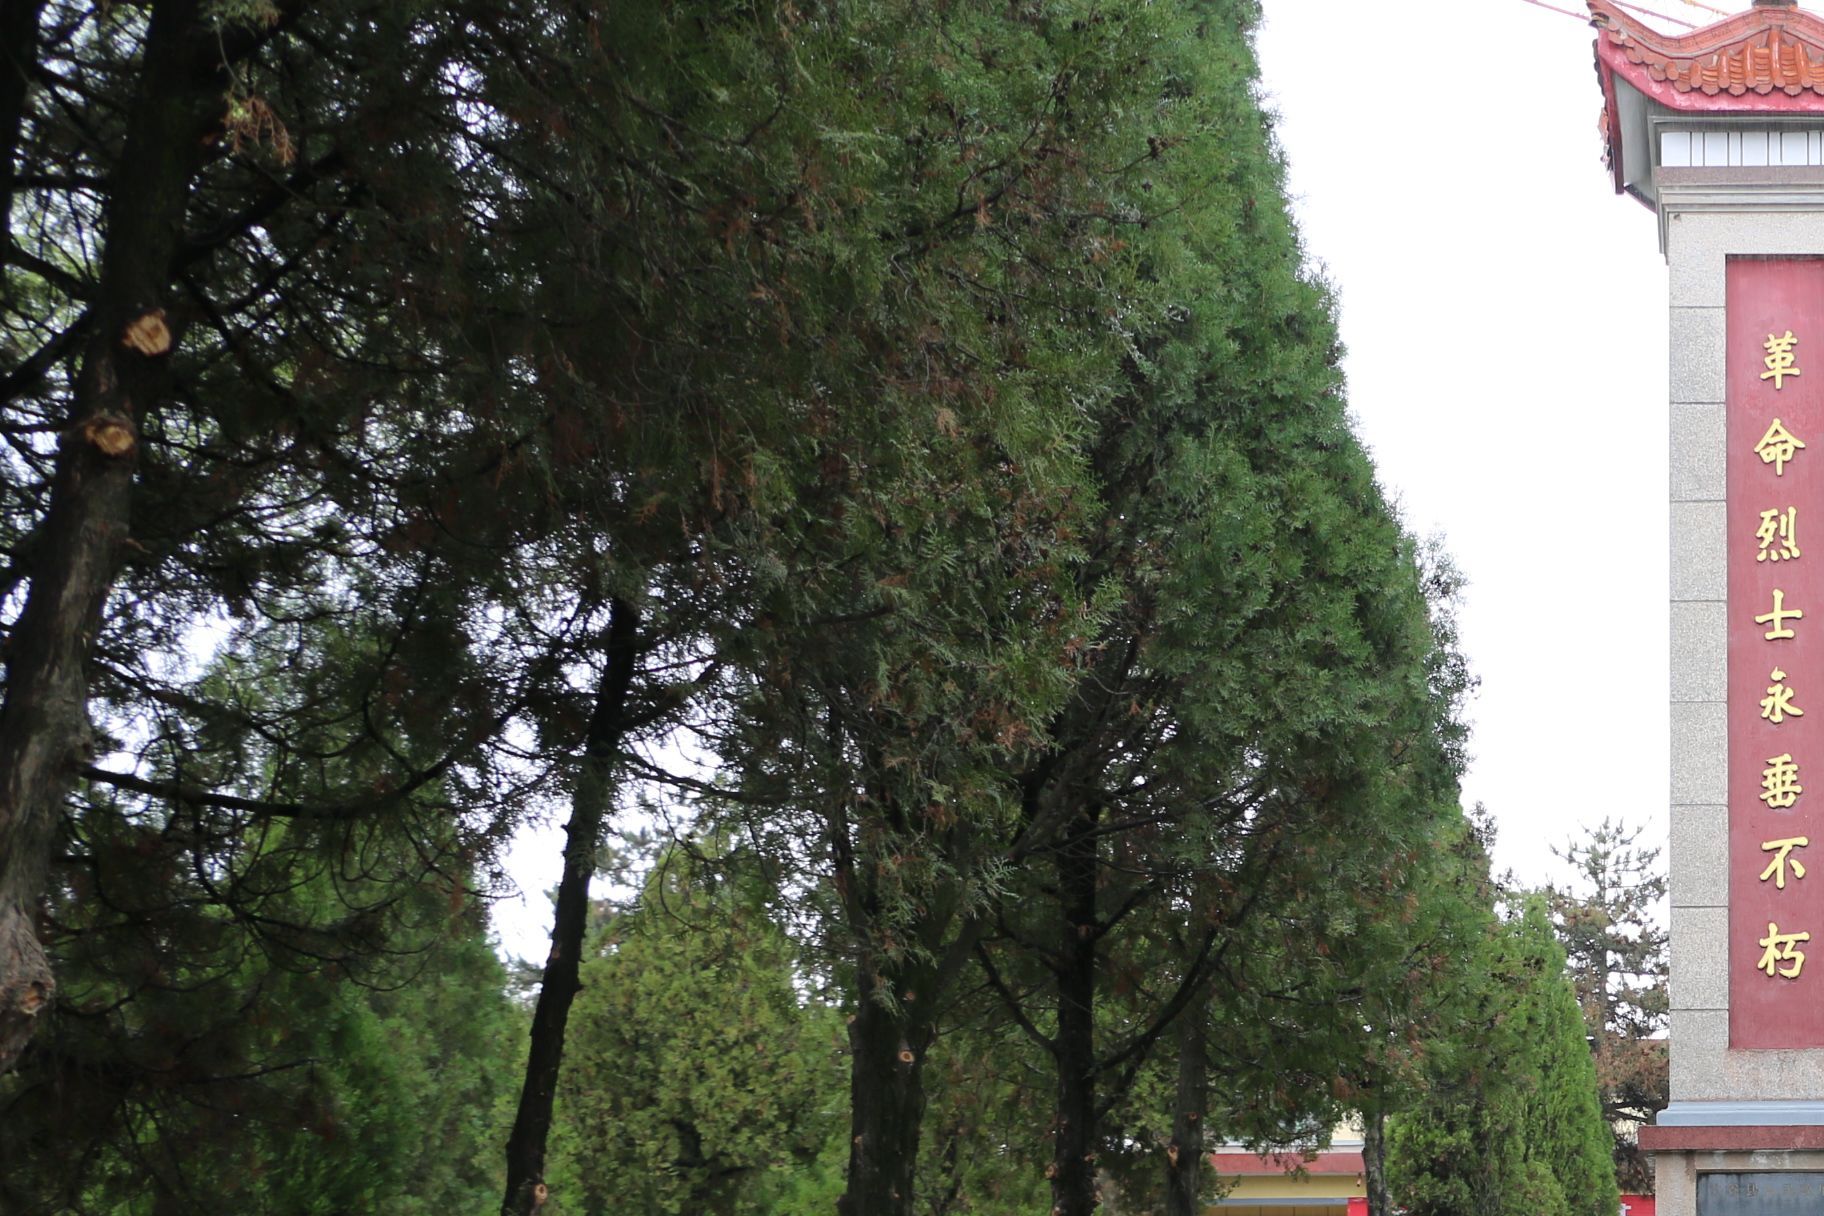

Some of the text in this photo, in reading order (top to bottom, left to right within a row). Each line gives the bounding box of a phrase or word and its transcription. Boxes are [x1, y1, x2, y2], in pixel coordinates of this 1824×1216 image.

[1754, 330, 1811, 981] 革命烈士永垂不朽
